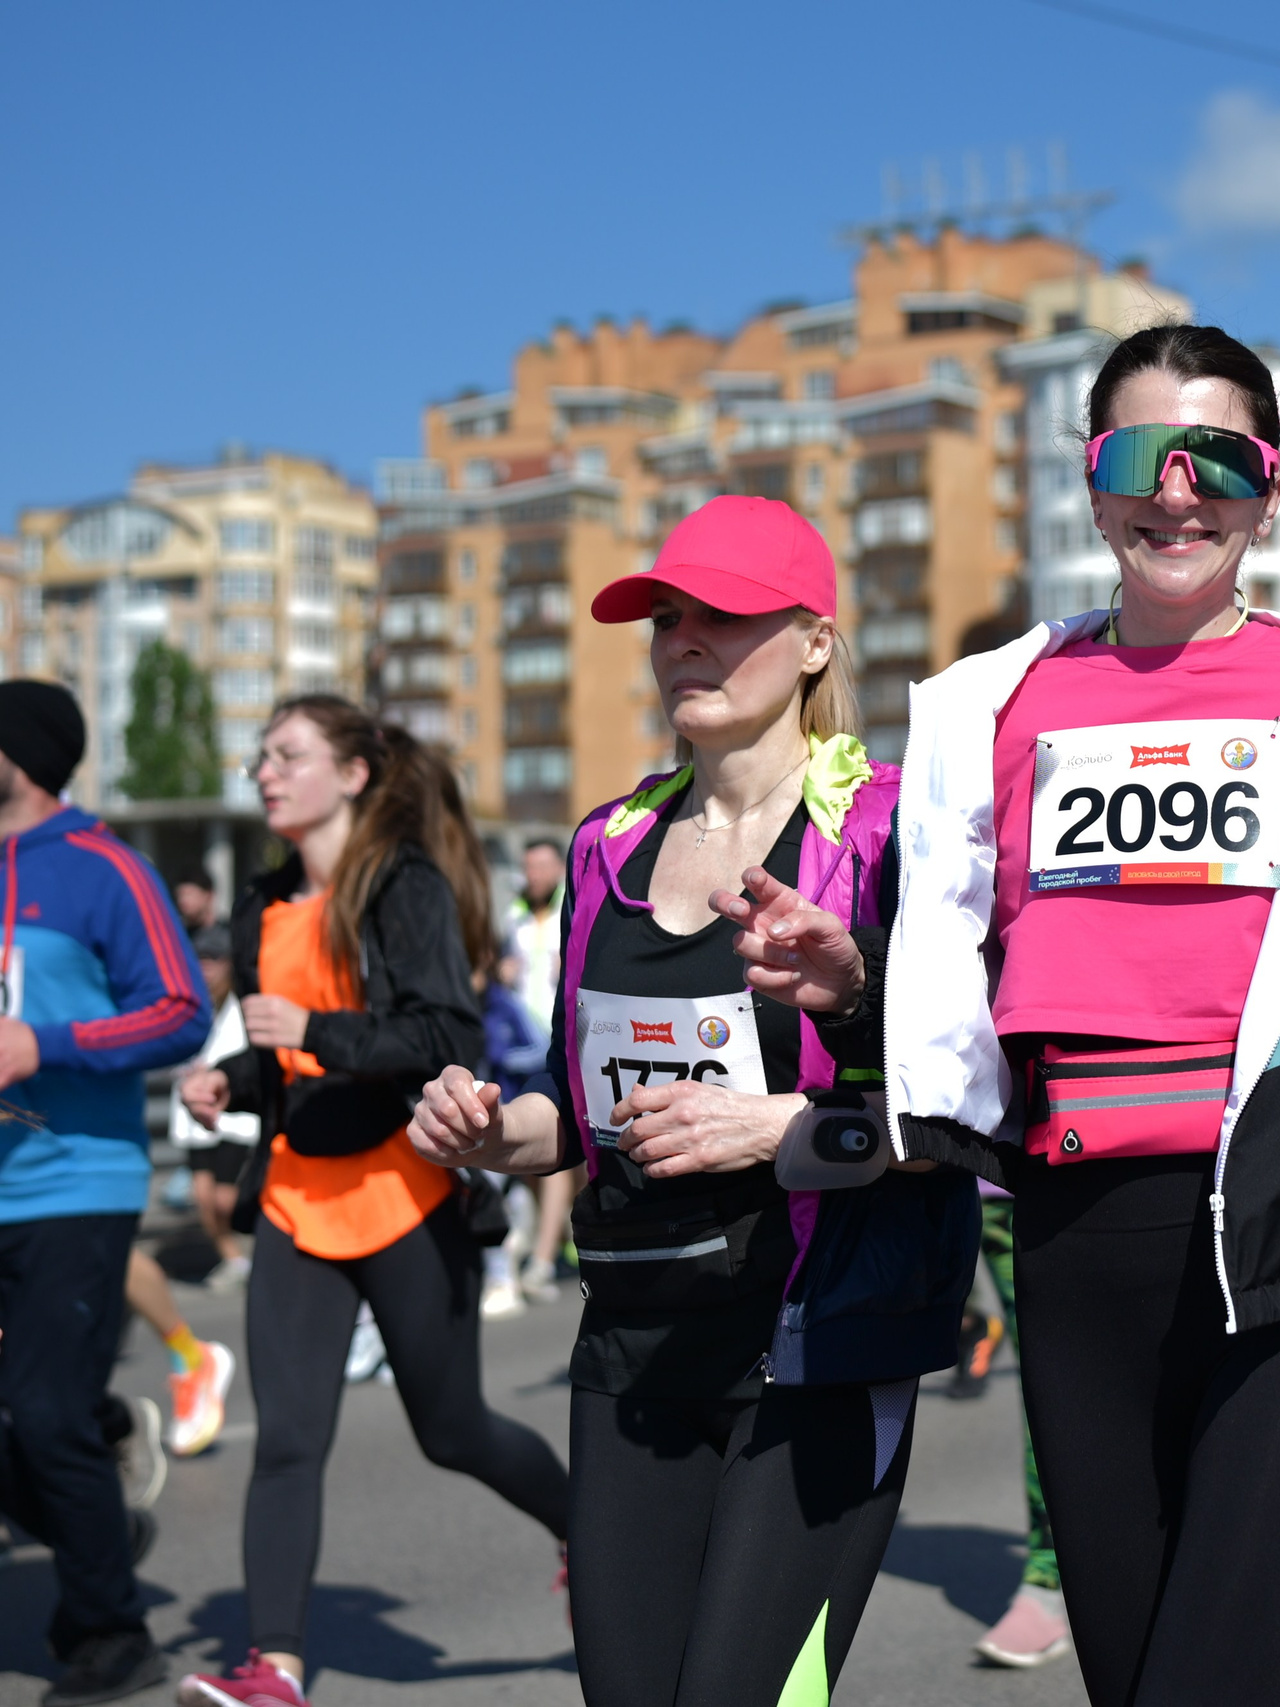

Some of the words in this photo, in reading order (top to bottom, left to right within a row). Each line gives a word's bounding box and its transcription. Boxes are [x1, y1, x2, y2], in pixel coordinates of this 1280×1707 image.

[1137, 752, 1163, 761] Альфа
[1164, 750, 1183, 758] Банк
[1055, 781, 1260, 856] 2096
[1038, 871, 1078, 882] Ежегодный
[1038, 878, 1075, 889] городской
[1076, 875, 1102, 885] пробег
